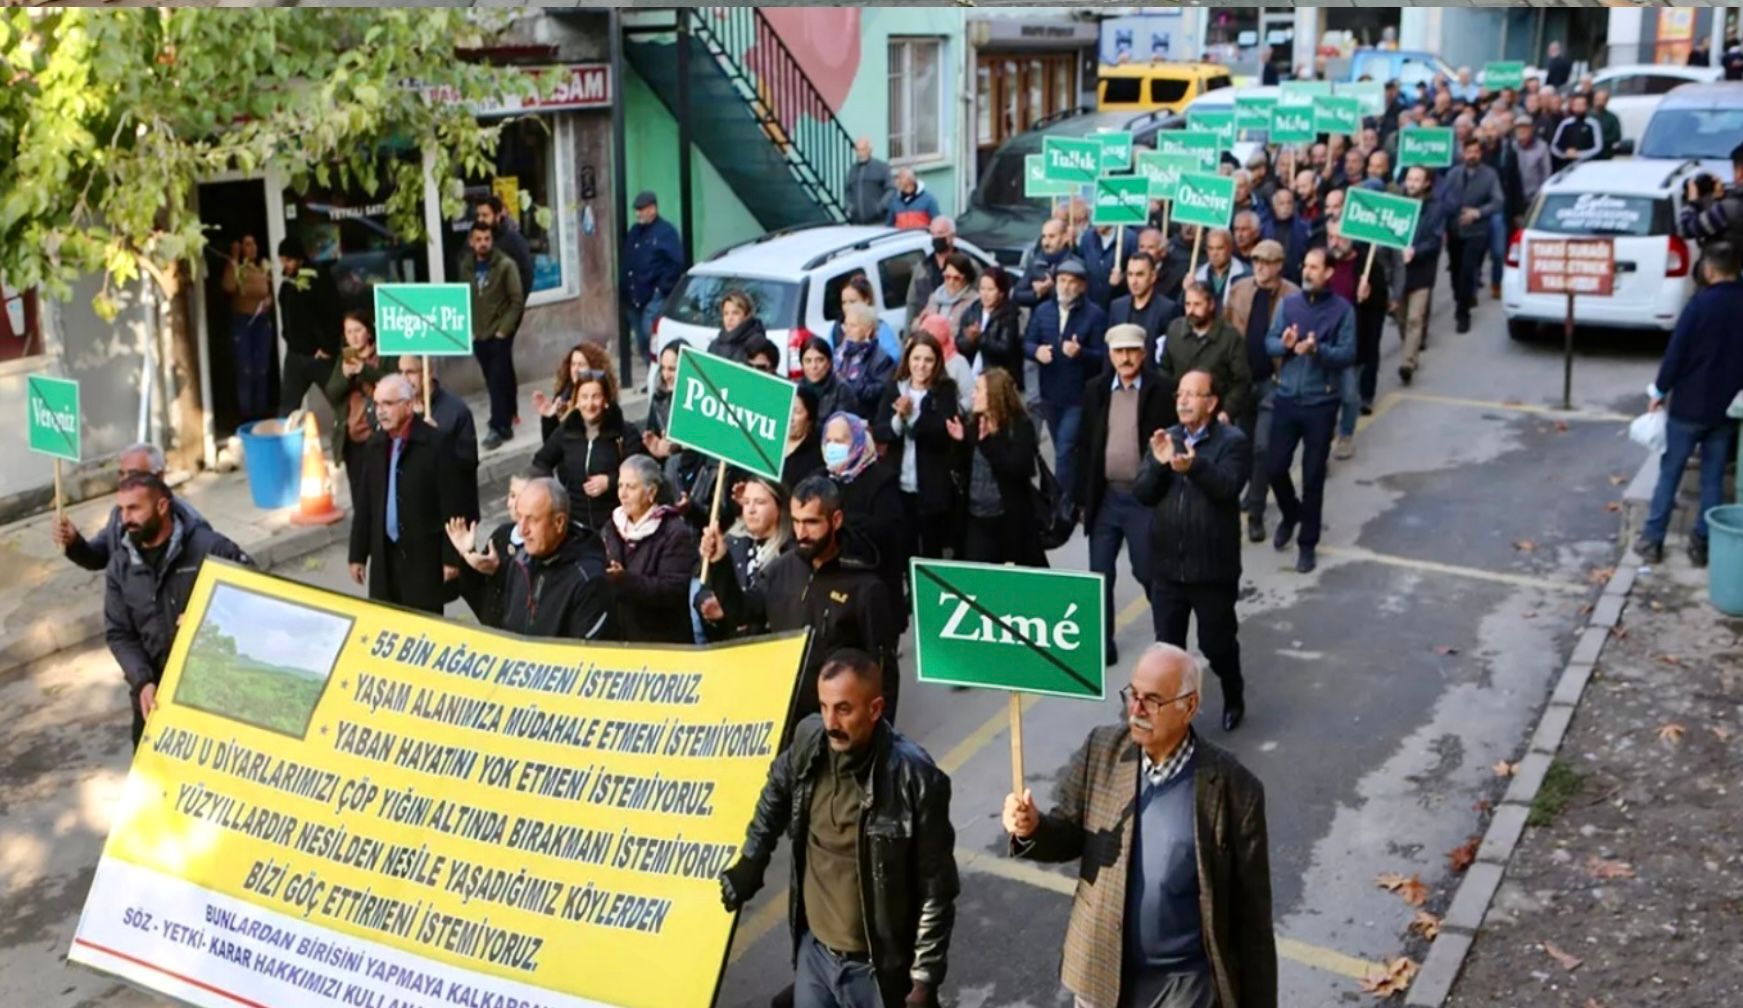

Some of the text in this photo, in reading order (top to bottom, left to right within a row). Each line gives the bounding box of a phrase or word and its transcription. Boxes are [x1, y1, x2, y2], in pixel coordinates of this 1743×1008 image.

[440, 305, 465, 331] Pir
[683, 377, 777, 440] Poluvu
[371, 630, 703, 704] 55 BİN AĞACI KESMENİ İSTEMİYORUZ.
[354, 673, 774, 757] YAŞAM ALANIMIZA MÜDAHALE ETMENİ İSTEMİYORUZ.
[154, 727, 199, 761] JARU
[198, 739, 214, 766] U
[211, 738, 342, 804] DİYARLARIMIZI
[335, 776, 380, 815] ÇÖP
[377, 787, 434, 827] YIĞINI
[427, 800, 509, 846] ALTINDA
[507, 817, 614, 865] BIRAKMANI
[334, 720, 716, 816] YABAN HAYATINI YOK ETMENİ İSTEMİYORUZ.
[174, 782, 672, 934] YÜZYILLARDIR NESİLDEN NESİLE YAŞADIĞIMIZ KÖYLERDEN
[122, 906, 153, 932] SÖZ
[208, 936, 252, 969] KARAR
[253, 952, 344, 1001] HAKKIMIZI
[205, 903, 297, 952] BUNLARDAN
[295, 934, 367, 973] BİRİSİNİ
[365, 956, 445, 1000] YAPMAYA
[243, 858, 543, 972] BİZİ GÖÇ ETTİRMENİ İSTEMİYORUZ.
